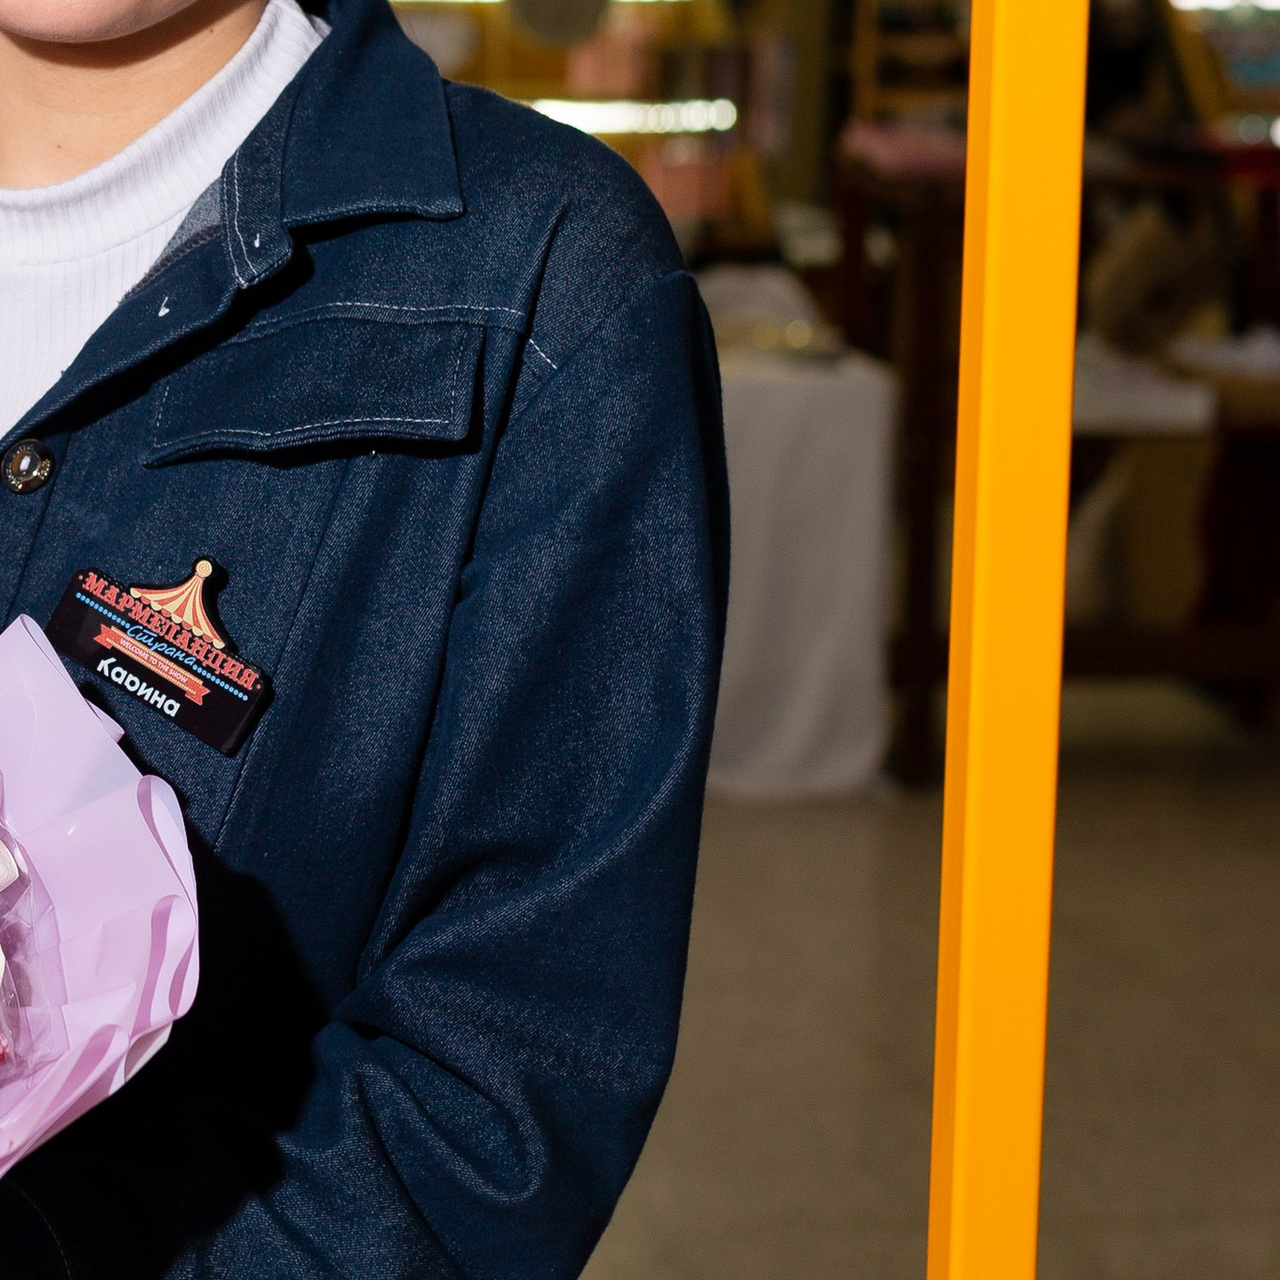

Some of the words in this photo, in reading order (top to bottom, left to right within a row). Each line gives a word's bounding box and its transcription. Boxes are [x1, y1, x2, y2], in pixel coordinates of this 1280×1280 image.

[82, 572, 260, 690] МАРМЕЛАНДИЯ
[126, 625, 197, 666] Страна
[120, 638, 149, 660] WELCOME
[157, 661, 170, 673] THE
[168, 667, 189, 684] SHOW
